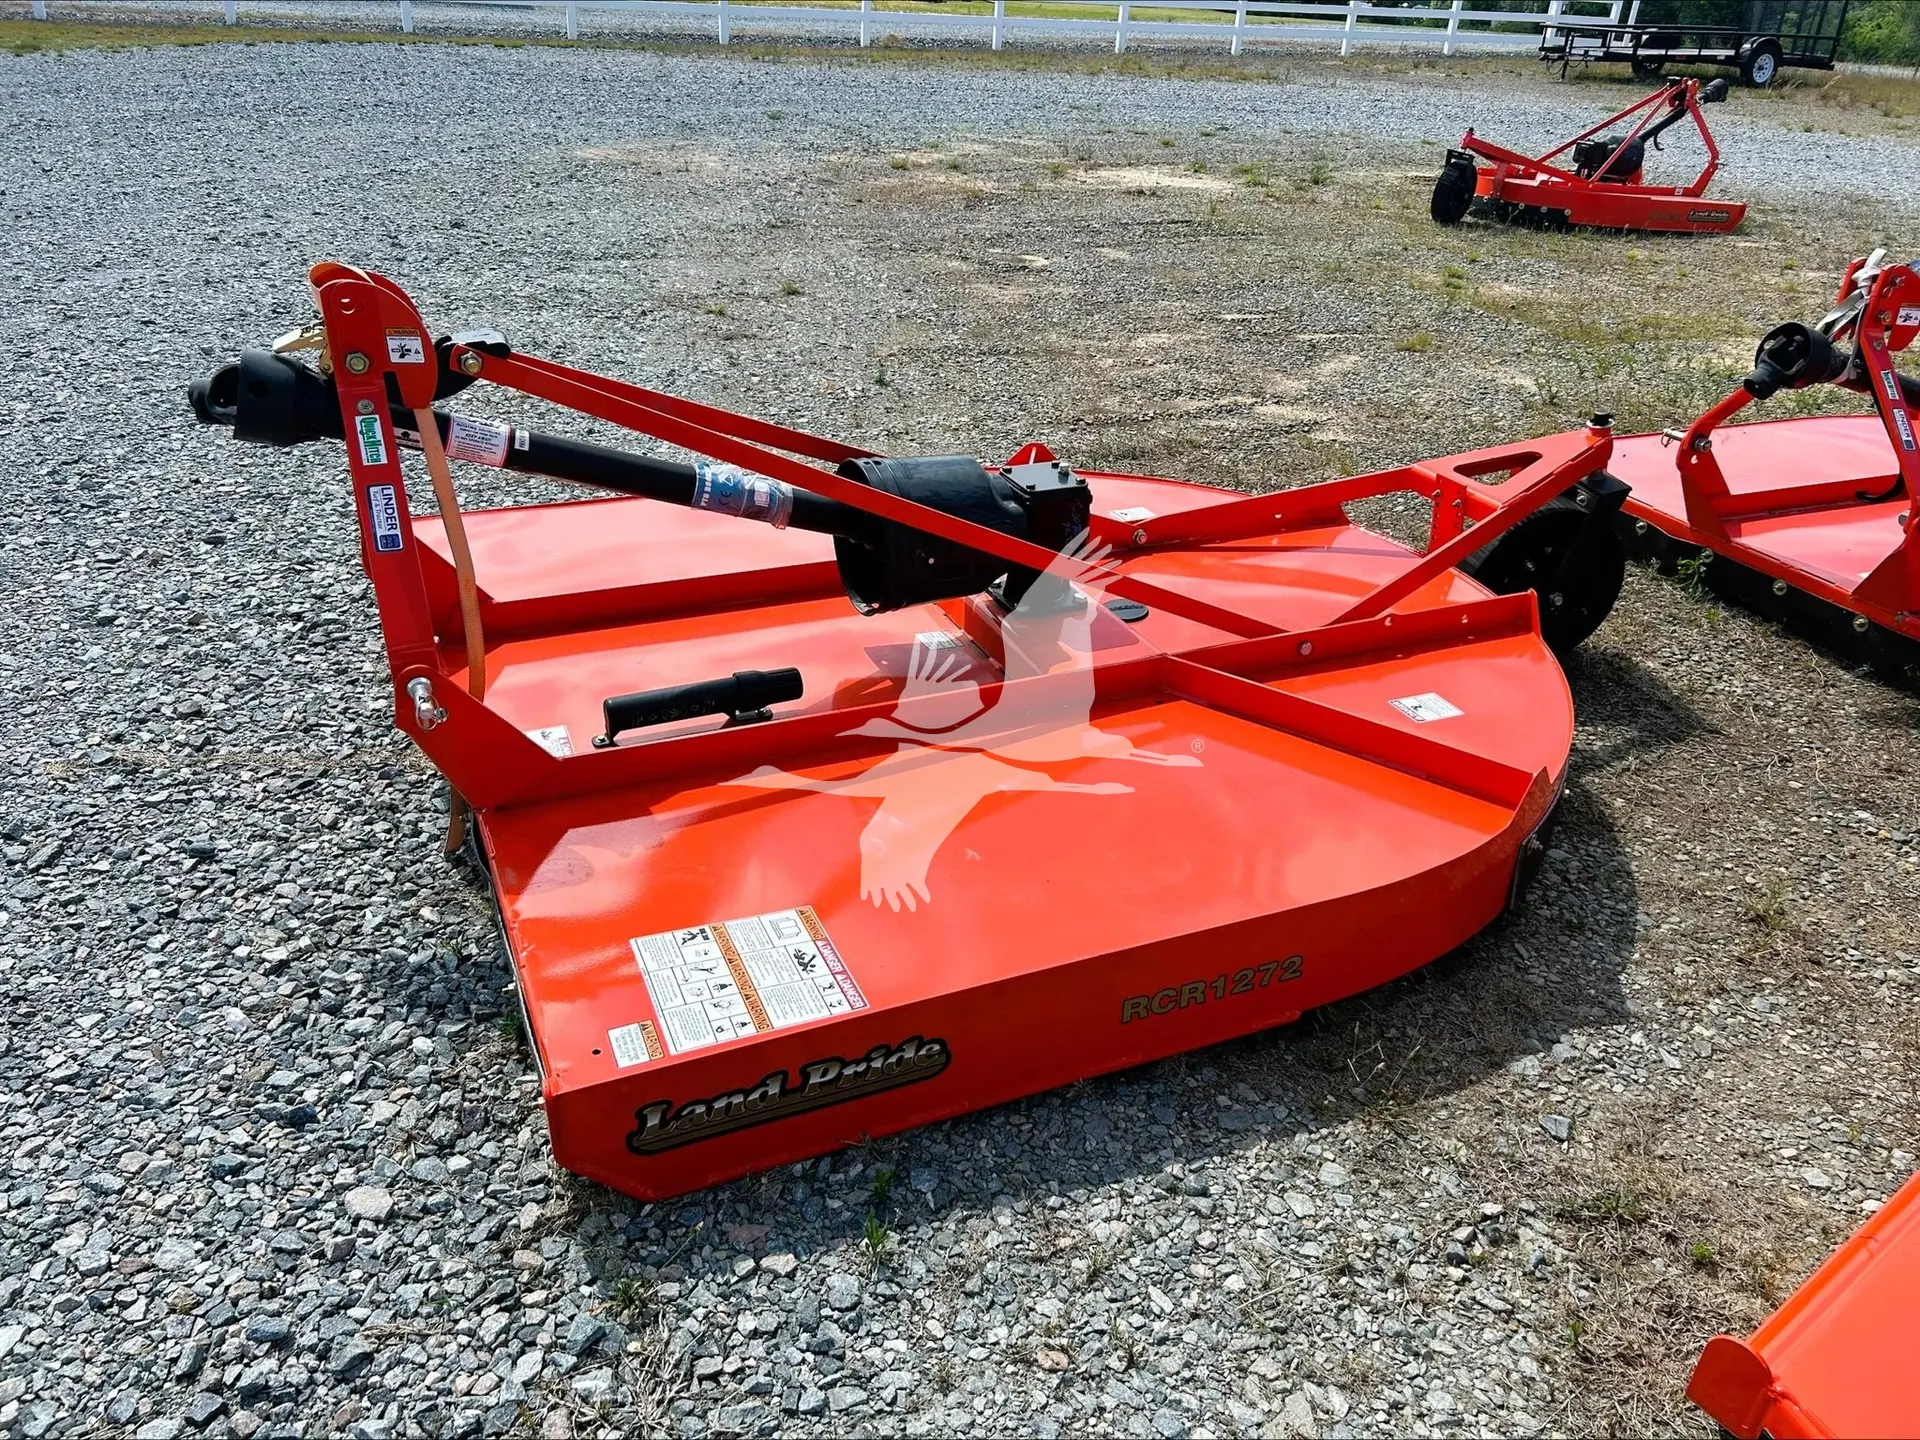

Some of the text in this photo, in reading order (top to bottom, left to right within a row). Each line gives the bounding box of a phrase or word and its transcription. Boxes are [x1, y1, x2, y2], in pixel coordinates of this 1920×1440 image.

[381, 487, 398, 531] LINDER
[717, 926, 735, 956] WARNING
[804, 910, 824, 940] WARNING
[731, 959, 752, 991] WARNING
[821, 945, 844, 973] DANGER
[841, 977, 864, 1008] DANGER
[1121, 955, 1304, 1025] RCR1272
[747, 996, 770, 1030] WARNING
[644, 1024, 662, 1058] WARNING
[637, 1038, 947, 1140] Land Pride
